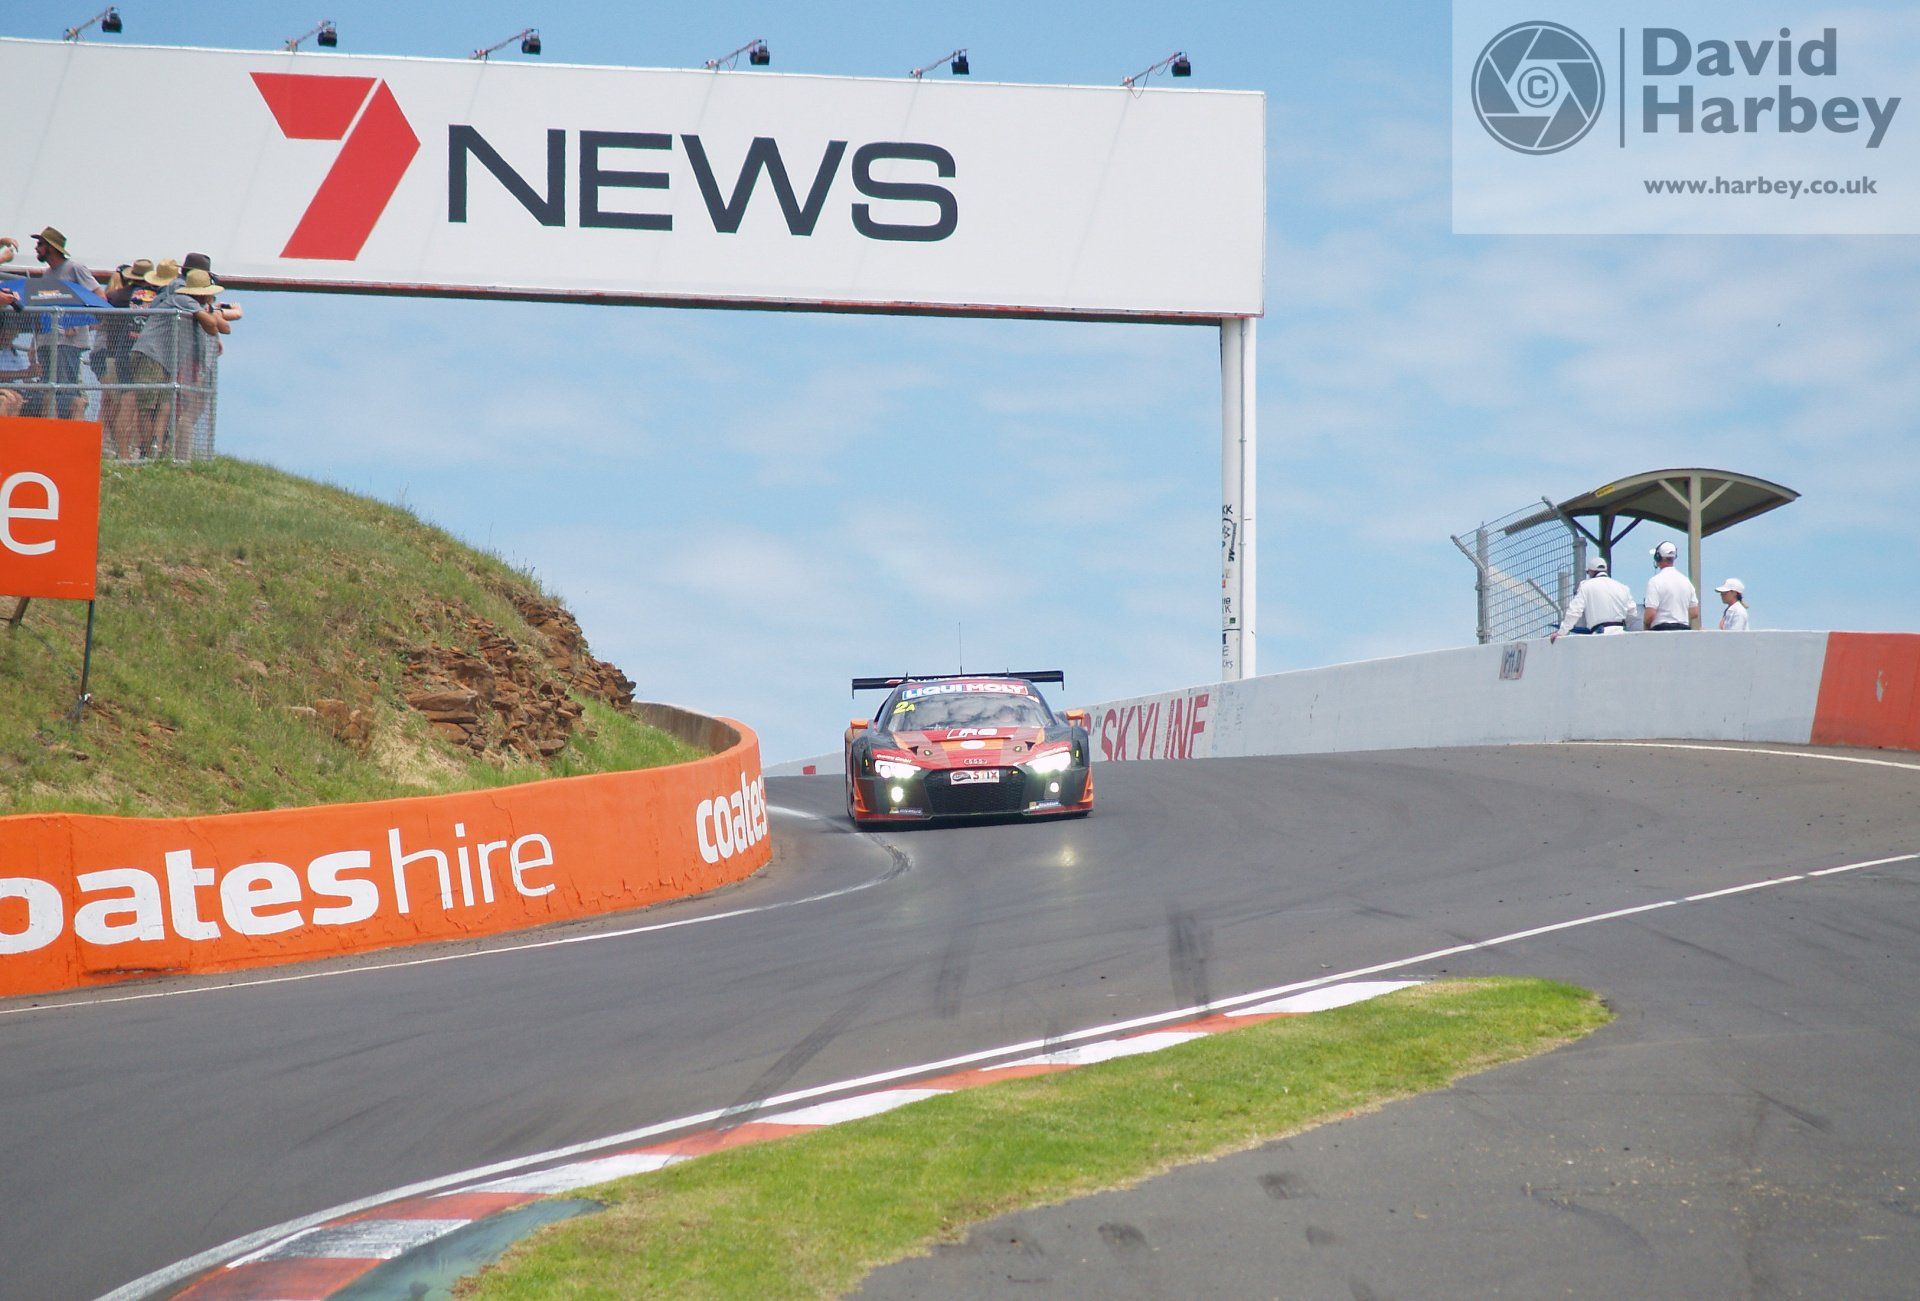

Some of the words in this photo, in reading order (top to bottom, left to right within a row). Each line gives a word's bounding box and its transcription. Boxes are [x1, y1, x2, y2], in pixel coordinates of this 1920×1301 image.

[250, 72, 421, 260] 7
[448, 124, 958, 241] NEWS
[906, 684, 962, 698] LIQUI
[966, 683, 1025, 694] MOLY
[1101, 693, 1210, 762] SKYLINE
[695, 771, 768, 864] coates
[388, 823, 556, 914] hire
